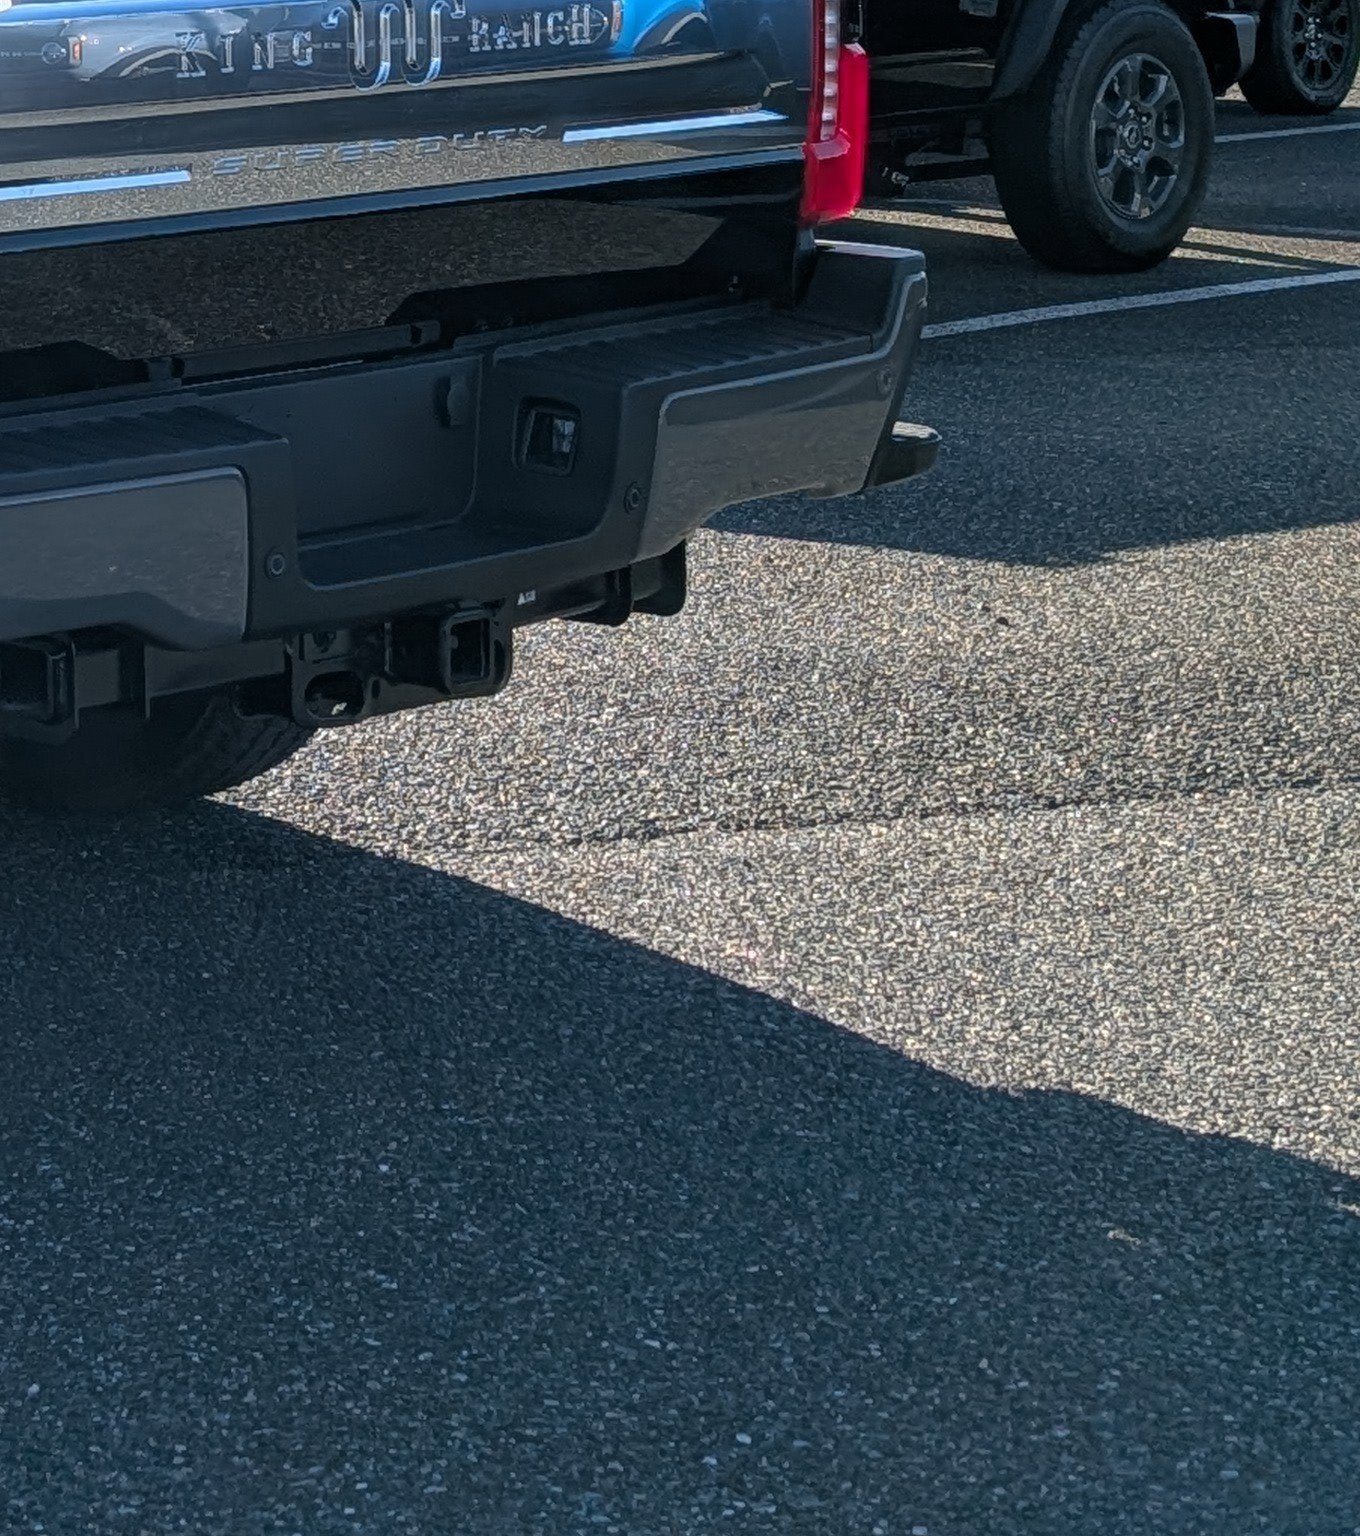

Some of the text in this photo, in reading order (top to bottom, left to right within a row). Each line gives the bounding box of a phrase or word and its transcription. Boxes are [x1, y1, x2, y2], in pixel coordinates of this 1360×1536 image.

[175, 3, 592, 78] KING RANCH
[212, 124, 547, 175] SUPER DUTY
